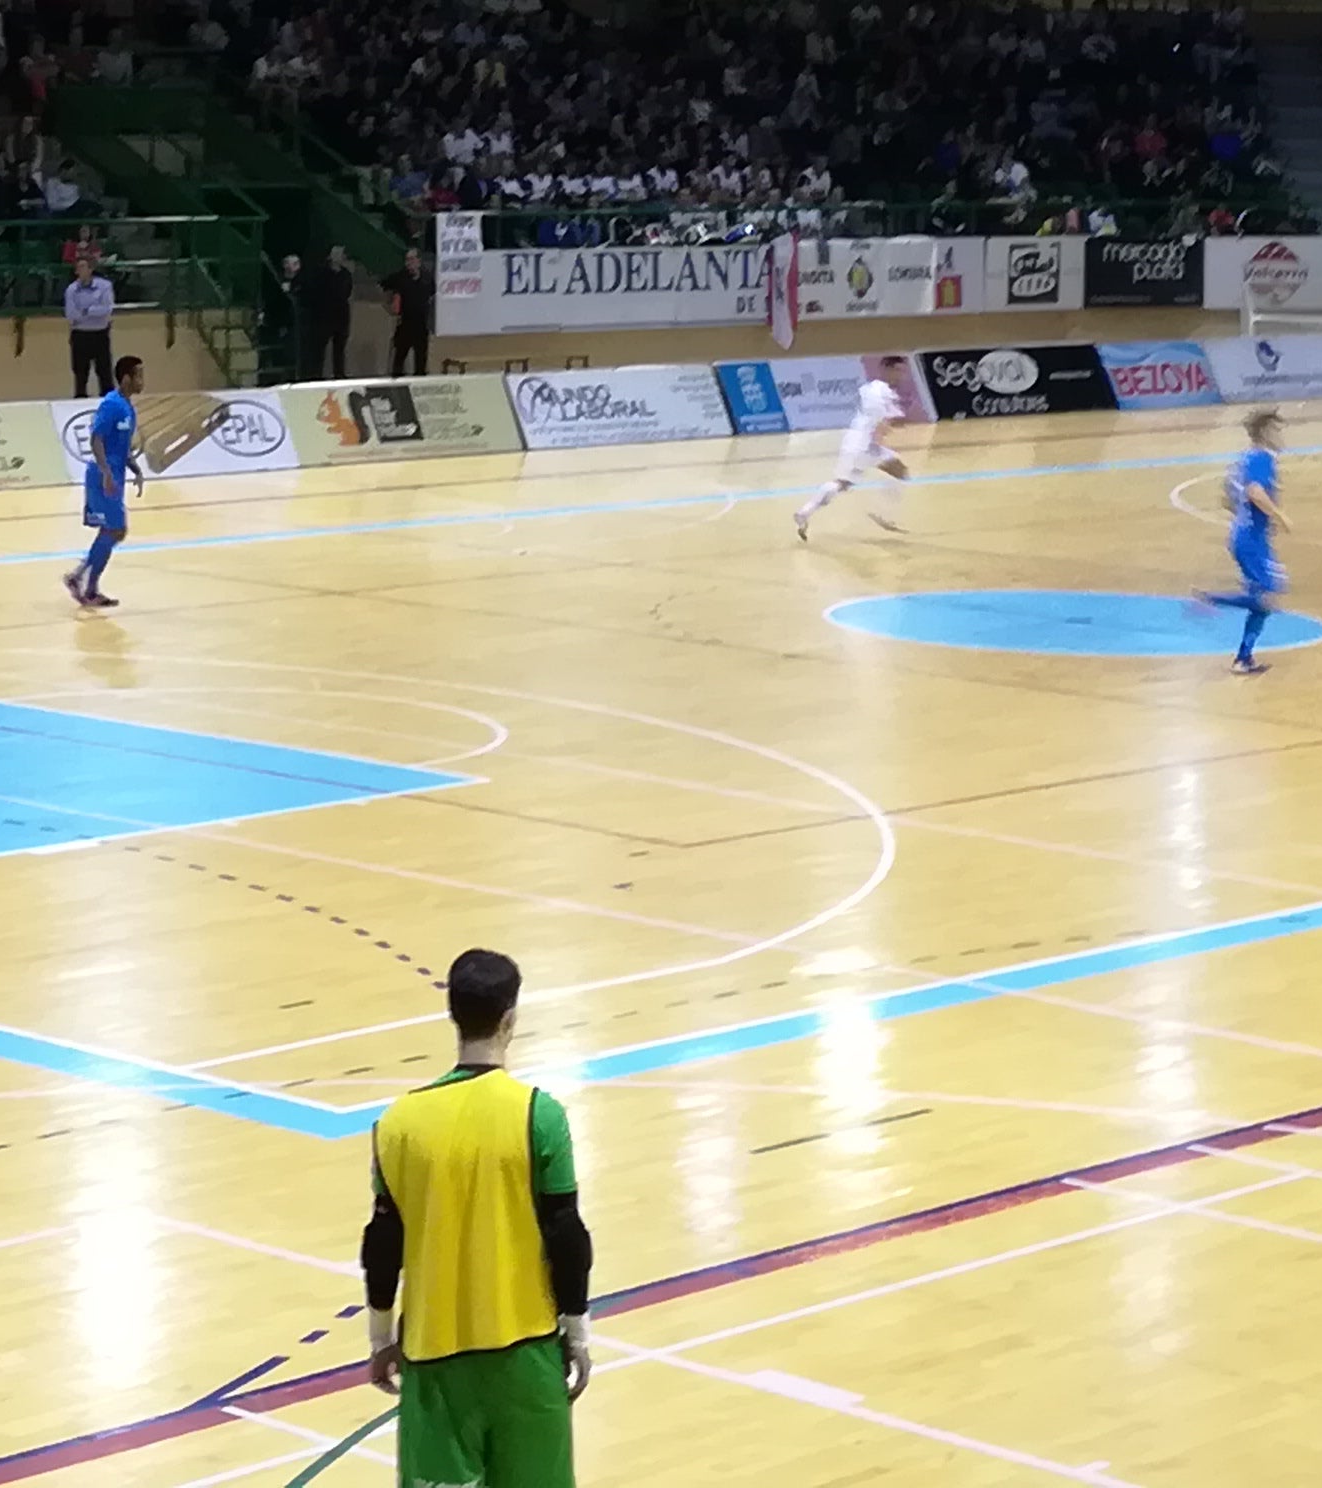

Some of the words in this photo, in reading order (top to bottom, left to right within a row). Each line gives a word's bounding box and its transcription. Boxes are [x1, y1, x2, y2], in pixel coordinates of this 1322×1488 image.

[502, 250, 558, 297] EL
[563, 244, 774, 296] ADELANTA
[736, 294, 757, 314] DE
[1110, 362, 1213, 397] BEZOYA
